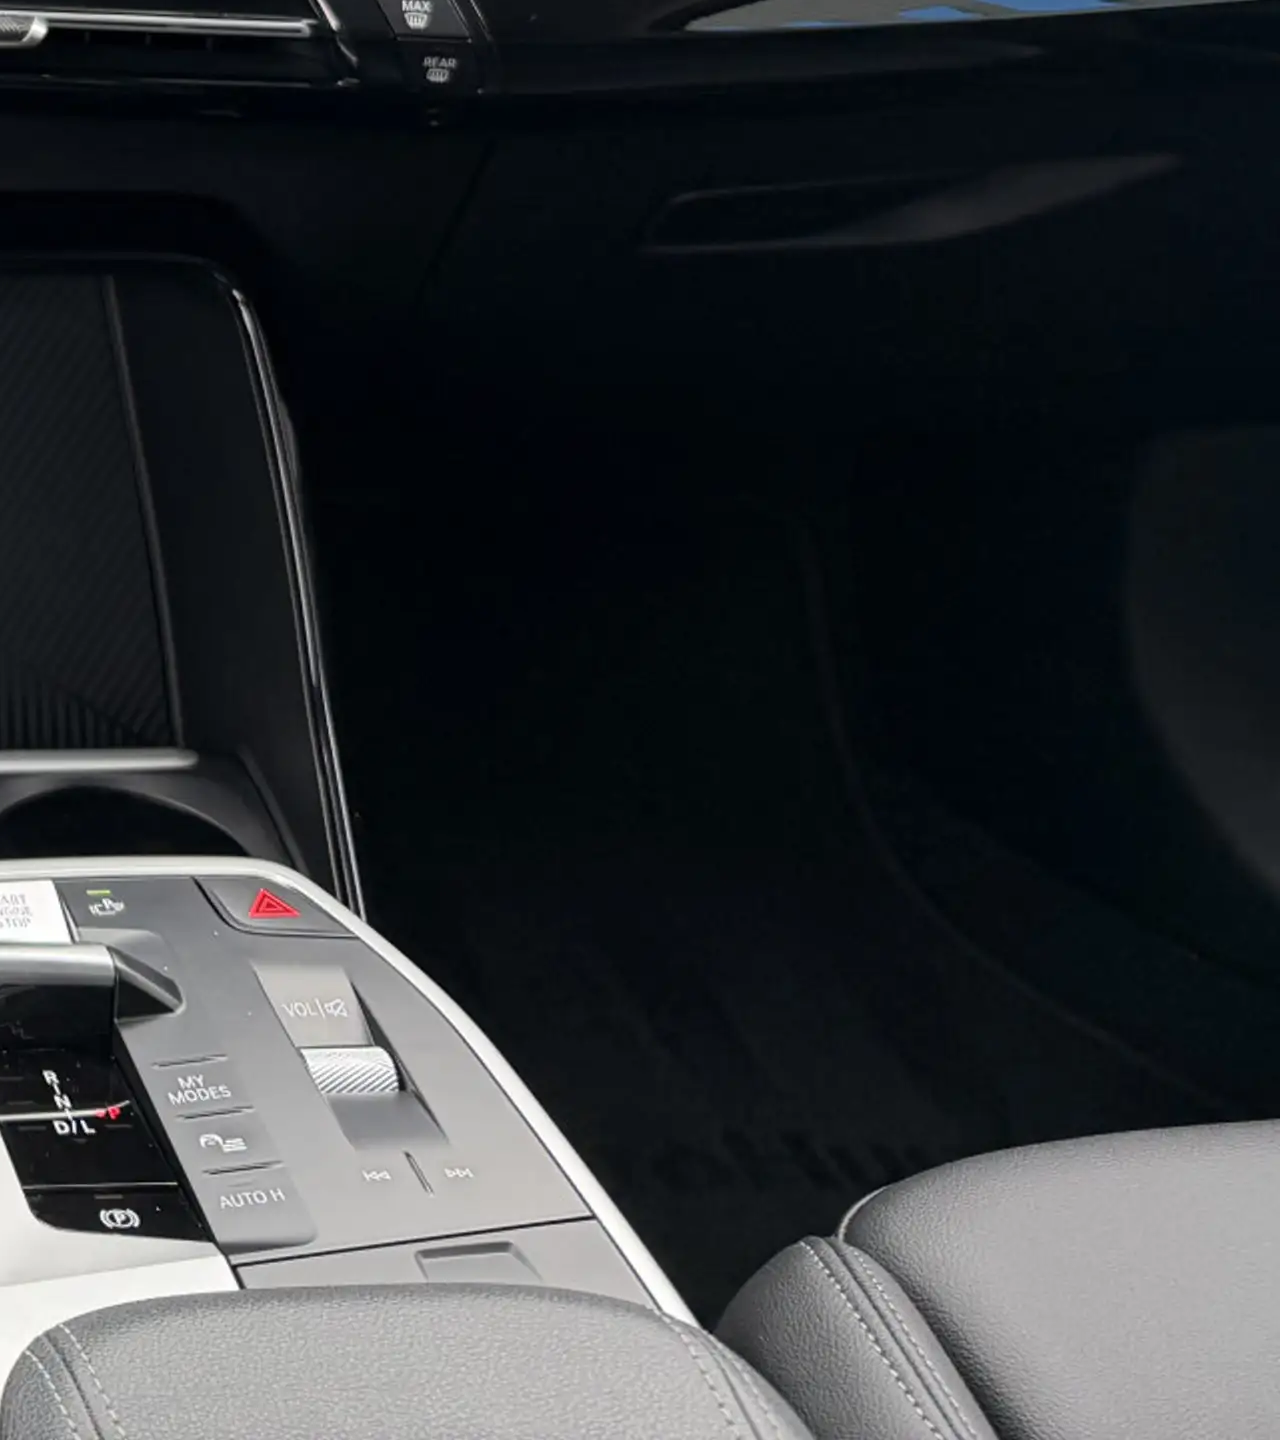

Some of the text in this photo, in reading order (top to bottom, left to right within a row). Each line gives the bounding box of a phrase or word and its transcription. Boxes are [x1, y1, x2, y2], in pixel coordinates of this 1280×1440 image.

[423, 57, 456, 68] REAR
[282, 1001, 318, 1018] VOL
[177, 1074, 205, 1089] MY
[54, 1094, 72, 1109] N
[167, 1085, 232, 1106] MODES
[219, 1187, 286, 1210] AUTO H
